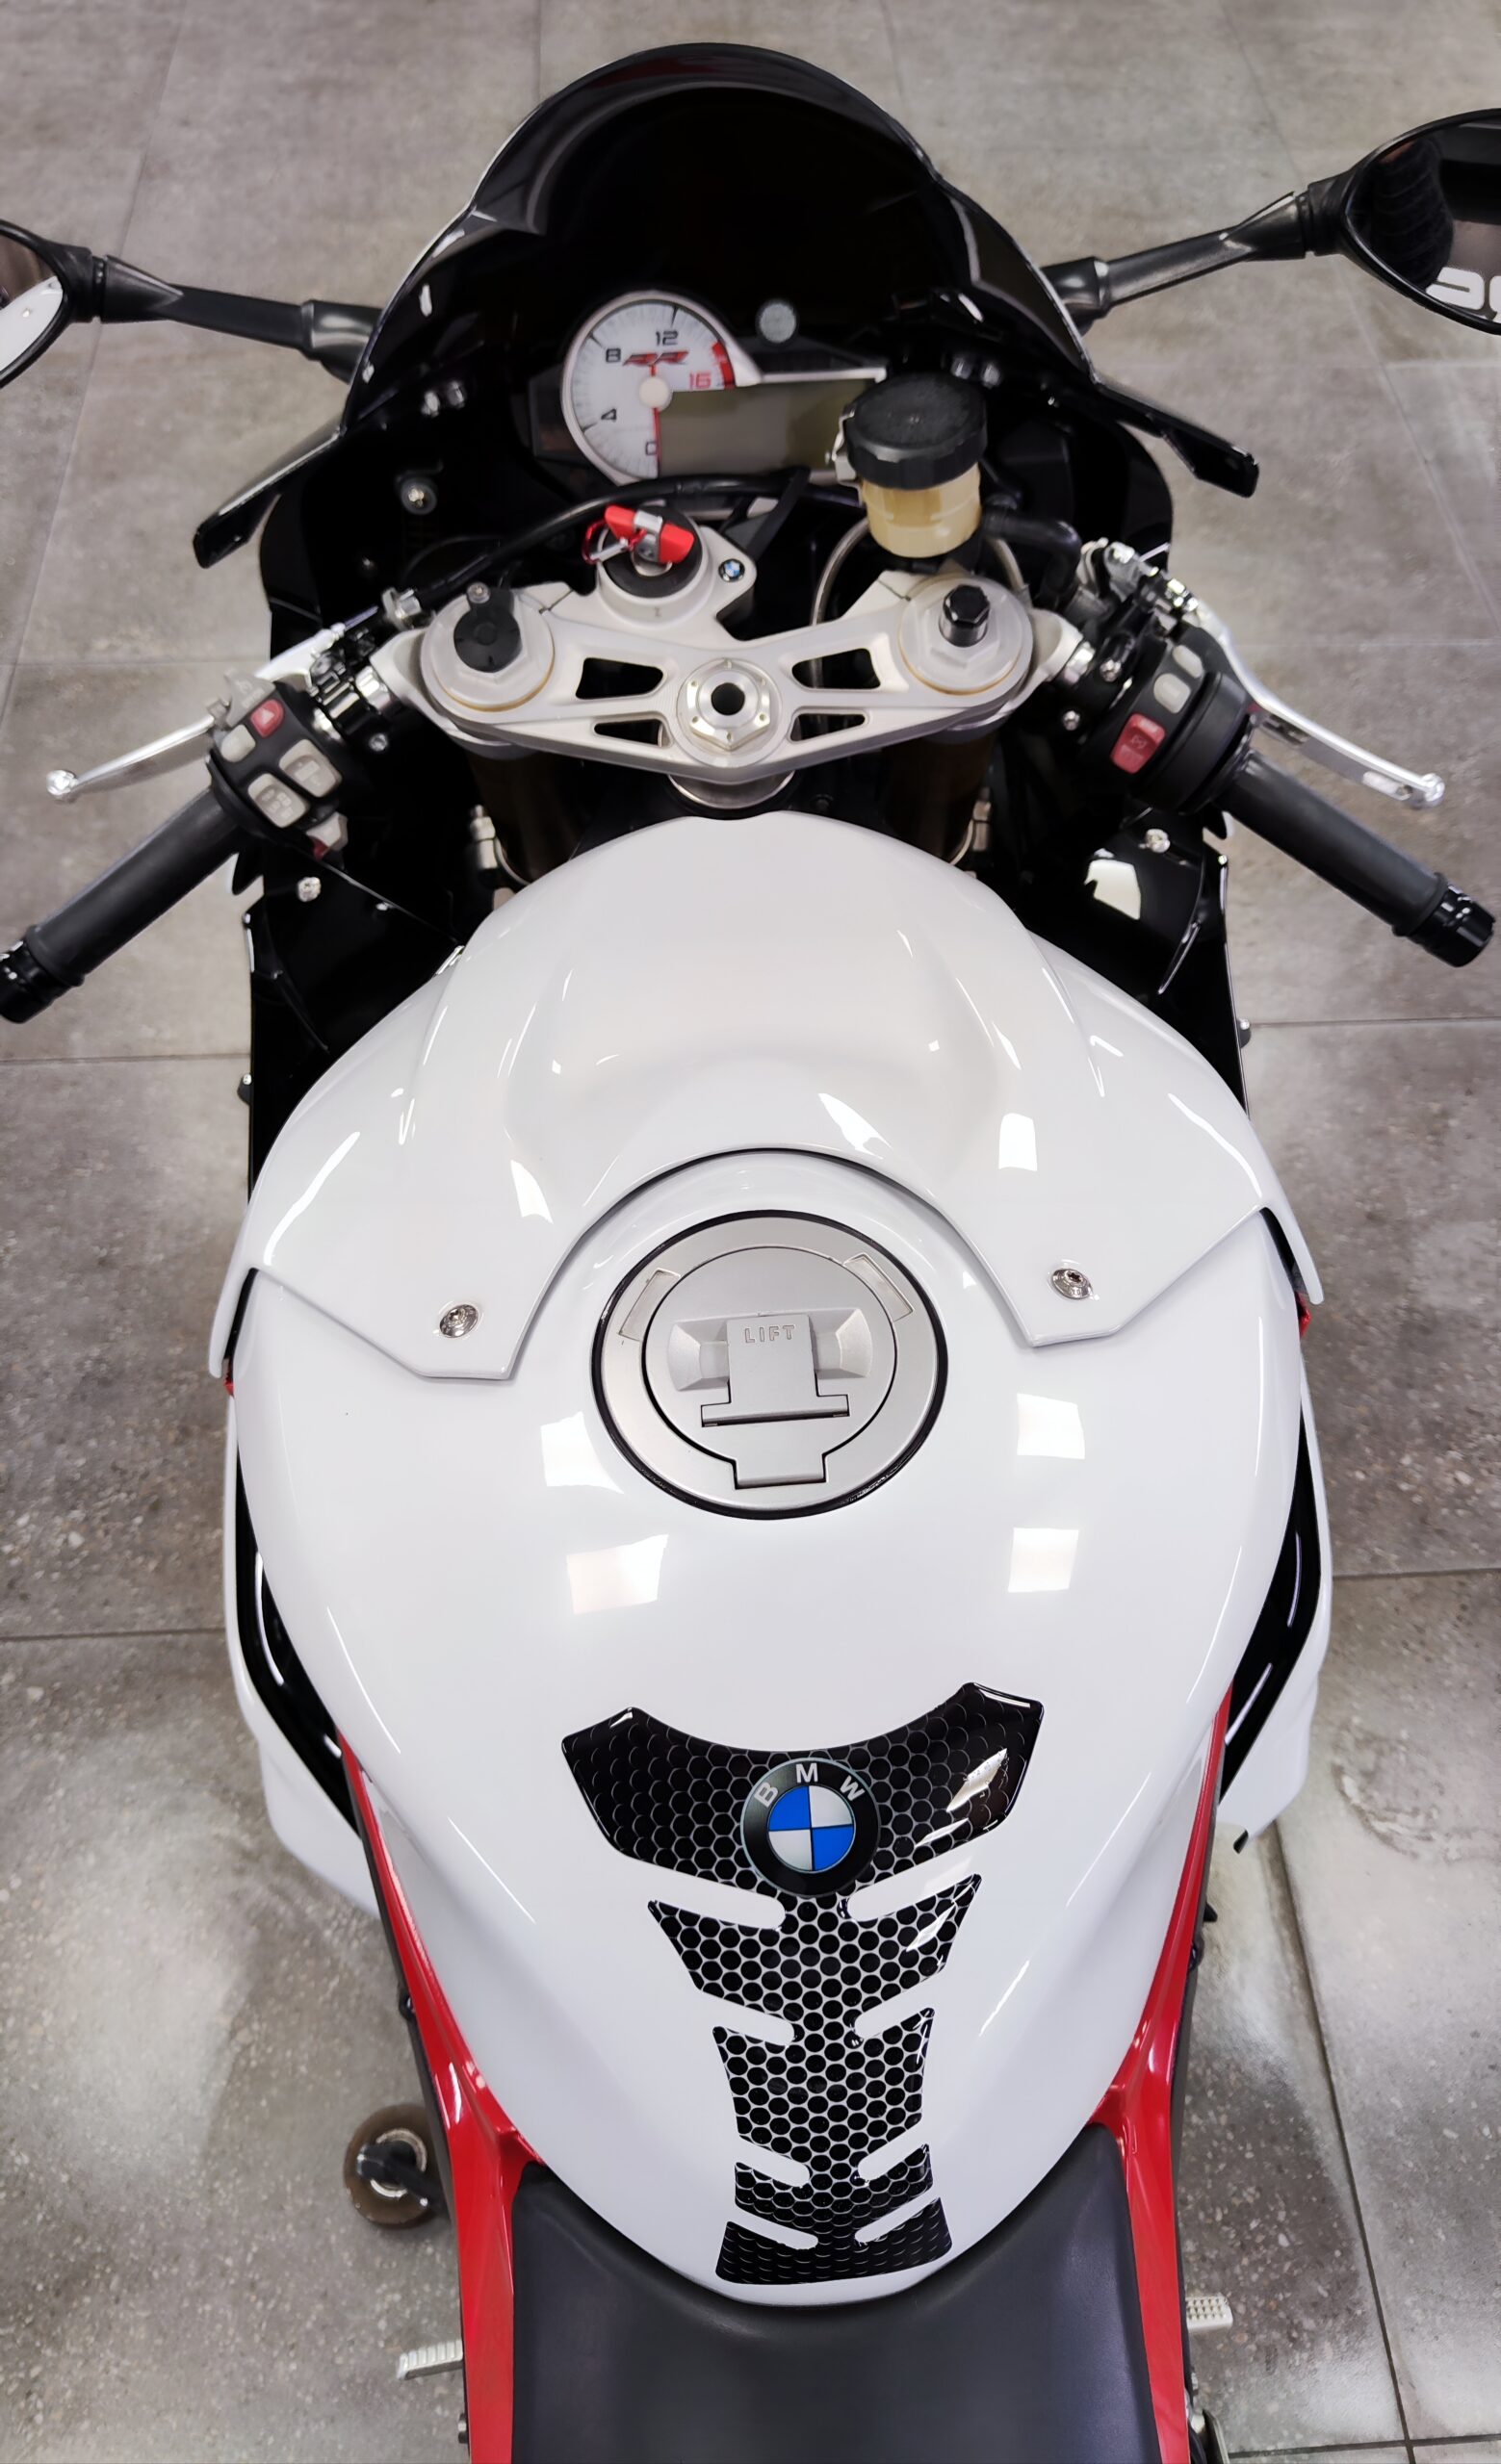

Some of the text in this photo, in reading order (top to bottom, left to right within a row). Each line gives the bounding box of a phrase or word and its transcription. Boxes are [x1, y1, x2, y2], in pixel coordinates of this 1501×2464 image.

[656, 330, 679, 346] 12
[606, 347, 621, 363] 8
[689, 372, 711, 390] 16
[601, 408, 617, 422] 4
[744, 1324, 795, 1344] LIFT
[753, 1762, 866, 1809] BMW
